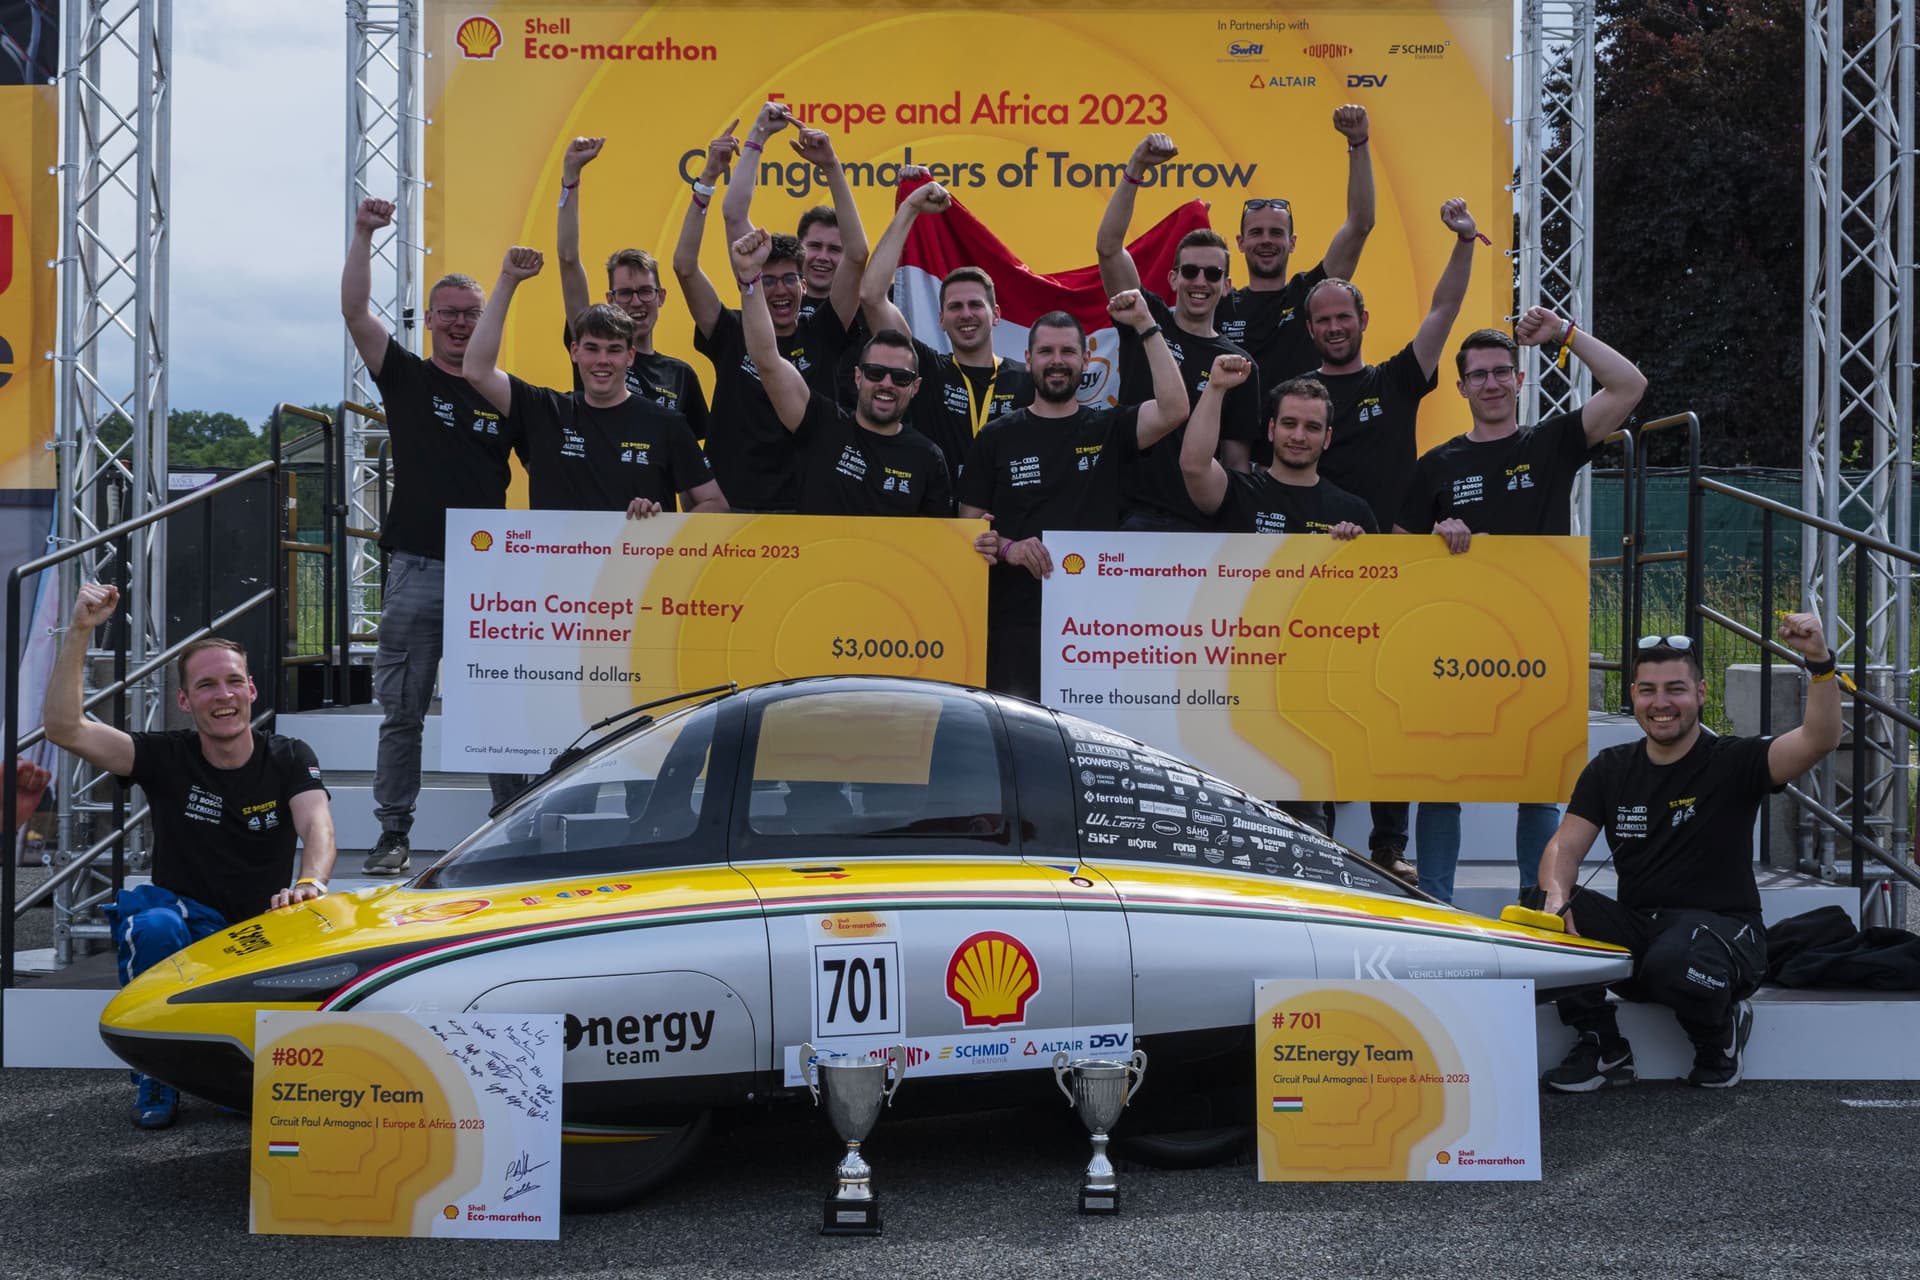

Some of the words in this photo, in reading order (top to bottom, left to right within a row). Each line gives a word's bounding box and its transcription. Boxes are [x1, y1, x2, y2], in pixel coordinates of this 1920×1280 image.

[525, 18, 570, 34] Shell
[1217, 20, 1227, 31] In
[1230, 20, 1286, 32] Partnership
[1288, 20, 1310, 31] with
[524, 37, 717, 61] Eco-marathon
[1230, 44, 1264, 56] SwRI
[1308, 44, 1348, 58] DUPONT
[1402, 44, 1445, 55] SCHMID
[1269, 76, 1317, 87] ALTAIR
[1347, 74, 1388, 88] DSV
[768, 92, 886, 134] urope
[902, 91, 961, 125] and
[970, 90, 1068, 126] Africa
[1078, 94, 1169, 126] 2023
[997, 147, 1039, 188] of
[1046, 151, 1258, 188] Tomorrow
[1020, 464, 1040, 472] BOSCH
[1462, 482, 1482, 490] BOSCH
[1264, 520, 1285, 528] BOSCH
[506, 530, 532, 540] Shell
[505, 541, 612, 555] Eco-marathon
[622, 543, 674, 560] Europe
[679, 544, 708, 556] and
[712, 544, 756, 558] Africa
[761, 545, 800, 560] 2023
[1098, 552, 1125, 563] Shell
[1098, 564, 1208, 578] Eco-marathon
[1218, 565, 1271, 582] Europe
[1276, 565, 1305, 579] and
[1310, 565, 1354, 580] Africa
[1359, 566, 1399, 580] 2023
[470, 592, 537, 614] Urban
[544, 594, 633, 620] Concept
[662, 597, 744, 622] Battery
[469, 619, 544, 641] Electric
[551, 622, 632, 642] Winner
[1061, 617, 1204, 638] Autonomous
[1211, 618, 1281, 638] Urban
[1288, 619, 1380, 644] Concept
[832, 636, 944, 660] $3,000.00
[1061, 645, 1197, 670] Competition
[1204, 646, 1287, 665] Winner
[467, 663, 509, 680] Three
[514, 664, 584, 682] thousand
[589, 666, 642, 682] dollars
[1432, 656, 1547, 681] $3,000.00
[1060, 688, 1104, 704] Three
[1108, 689, 1182, 706] thousand
[1186, 689, 1240, 706] dollars
[465, 745, 487, 754] Circuit
[488, 746, 504, 754] Paul
[505, 746, 541, 756] Armagnac
[1077, 756, 1130, 772] powersys
[199, 796, 223, 809] BOSCH
[1096, 792, 1134, 804] ferroton
[1232, 816, 1294, 840] BRIDGESTONE
[1088, 832, 1120, 844] SKF
[1128, 838, 1158, 849] BIOTEK
[1264, 838, 1287, 848] POWER
[1172, 842, 1196, 853] rona
[838, 922, 886, 930] Eco-marathon
[1408, 970, 1444, 979] VEHICLE
[1444, 968, 1486, 978] INDUSTRY
[1688, 967, 1706, 980] Black
[823, 958, 887, 1024] 701
[1272, 1012, 1285, 1029] #
[1289, 1012, 1322, 1029] 701
[1041, 1040, 1084, 1052] ALTAIR
[1090, 1033, 1128, 1048] DSV
[272, 1048, 324, 1066] #802
[956, 1042, 1009, 1058] SCHMID
[1273, 1044, 1360, 1066] SZEnergy
[1364, 1044, 1414, 1062] Team
[606, 1049, 660, 1066] team
[972, 1056, 1008, 1064] Elektronik
[1273, 1074, 1300, 1084] Circuit
[1302, 1074, 1320, 1084] Paul
[1322, 1074, 1368, 1086] Armagnac
[1376, 1074, 1408, 1086] Europe
[1410, 1074, 1417, 1084] &
[1418, 1074, 1445, 1084] Africa
[1446, 1074, 1470, 1084] 2023
[272, 1083, 366, 1108] SZEnergy
[370, 1084, 424, 1104] Team
[270, 1116, 300, 1128] Circuit
[302, 1116, 321, 1128] Paul
[324, 1117, 372, 1130] Armagnac
[382, 1119, 416, 1132] Europe
[418, 1120, 426, 1130] &
[428, 1119, 457, 1130] Africa
[459, 1120, 485, 1130] 2023
[1458, 1156, 1526, 1166] Eco-marathon
[468, 1204, 486, 1212] Shell
[467, 1212, 542, 1222] Eco-marathon
